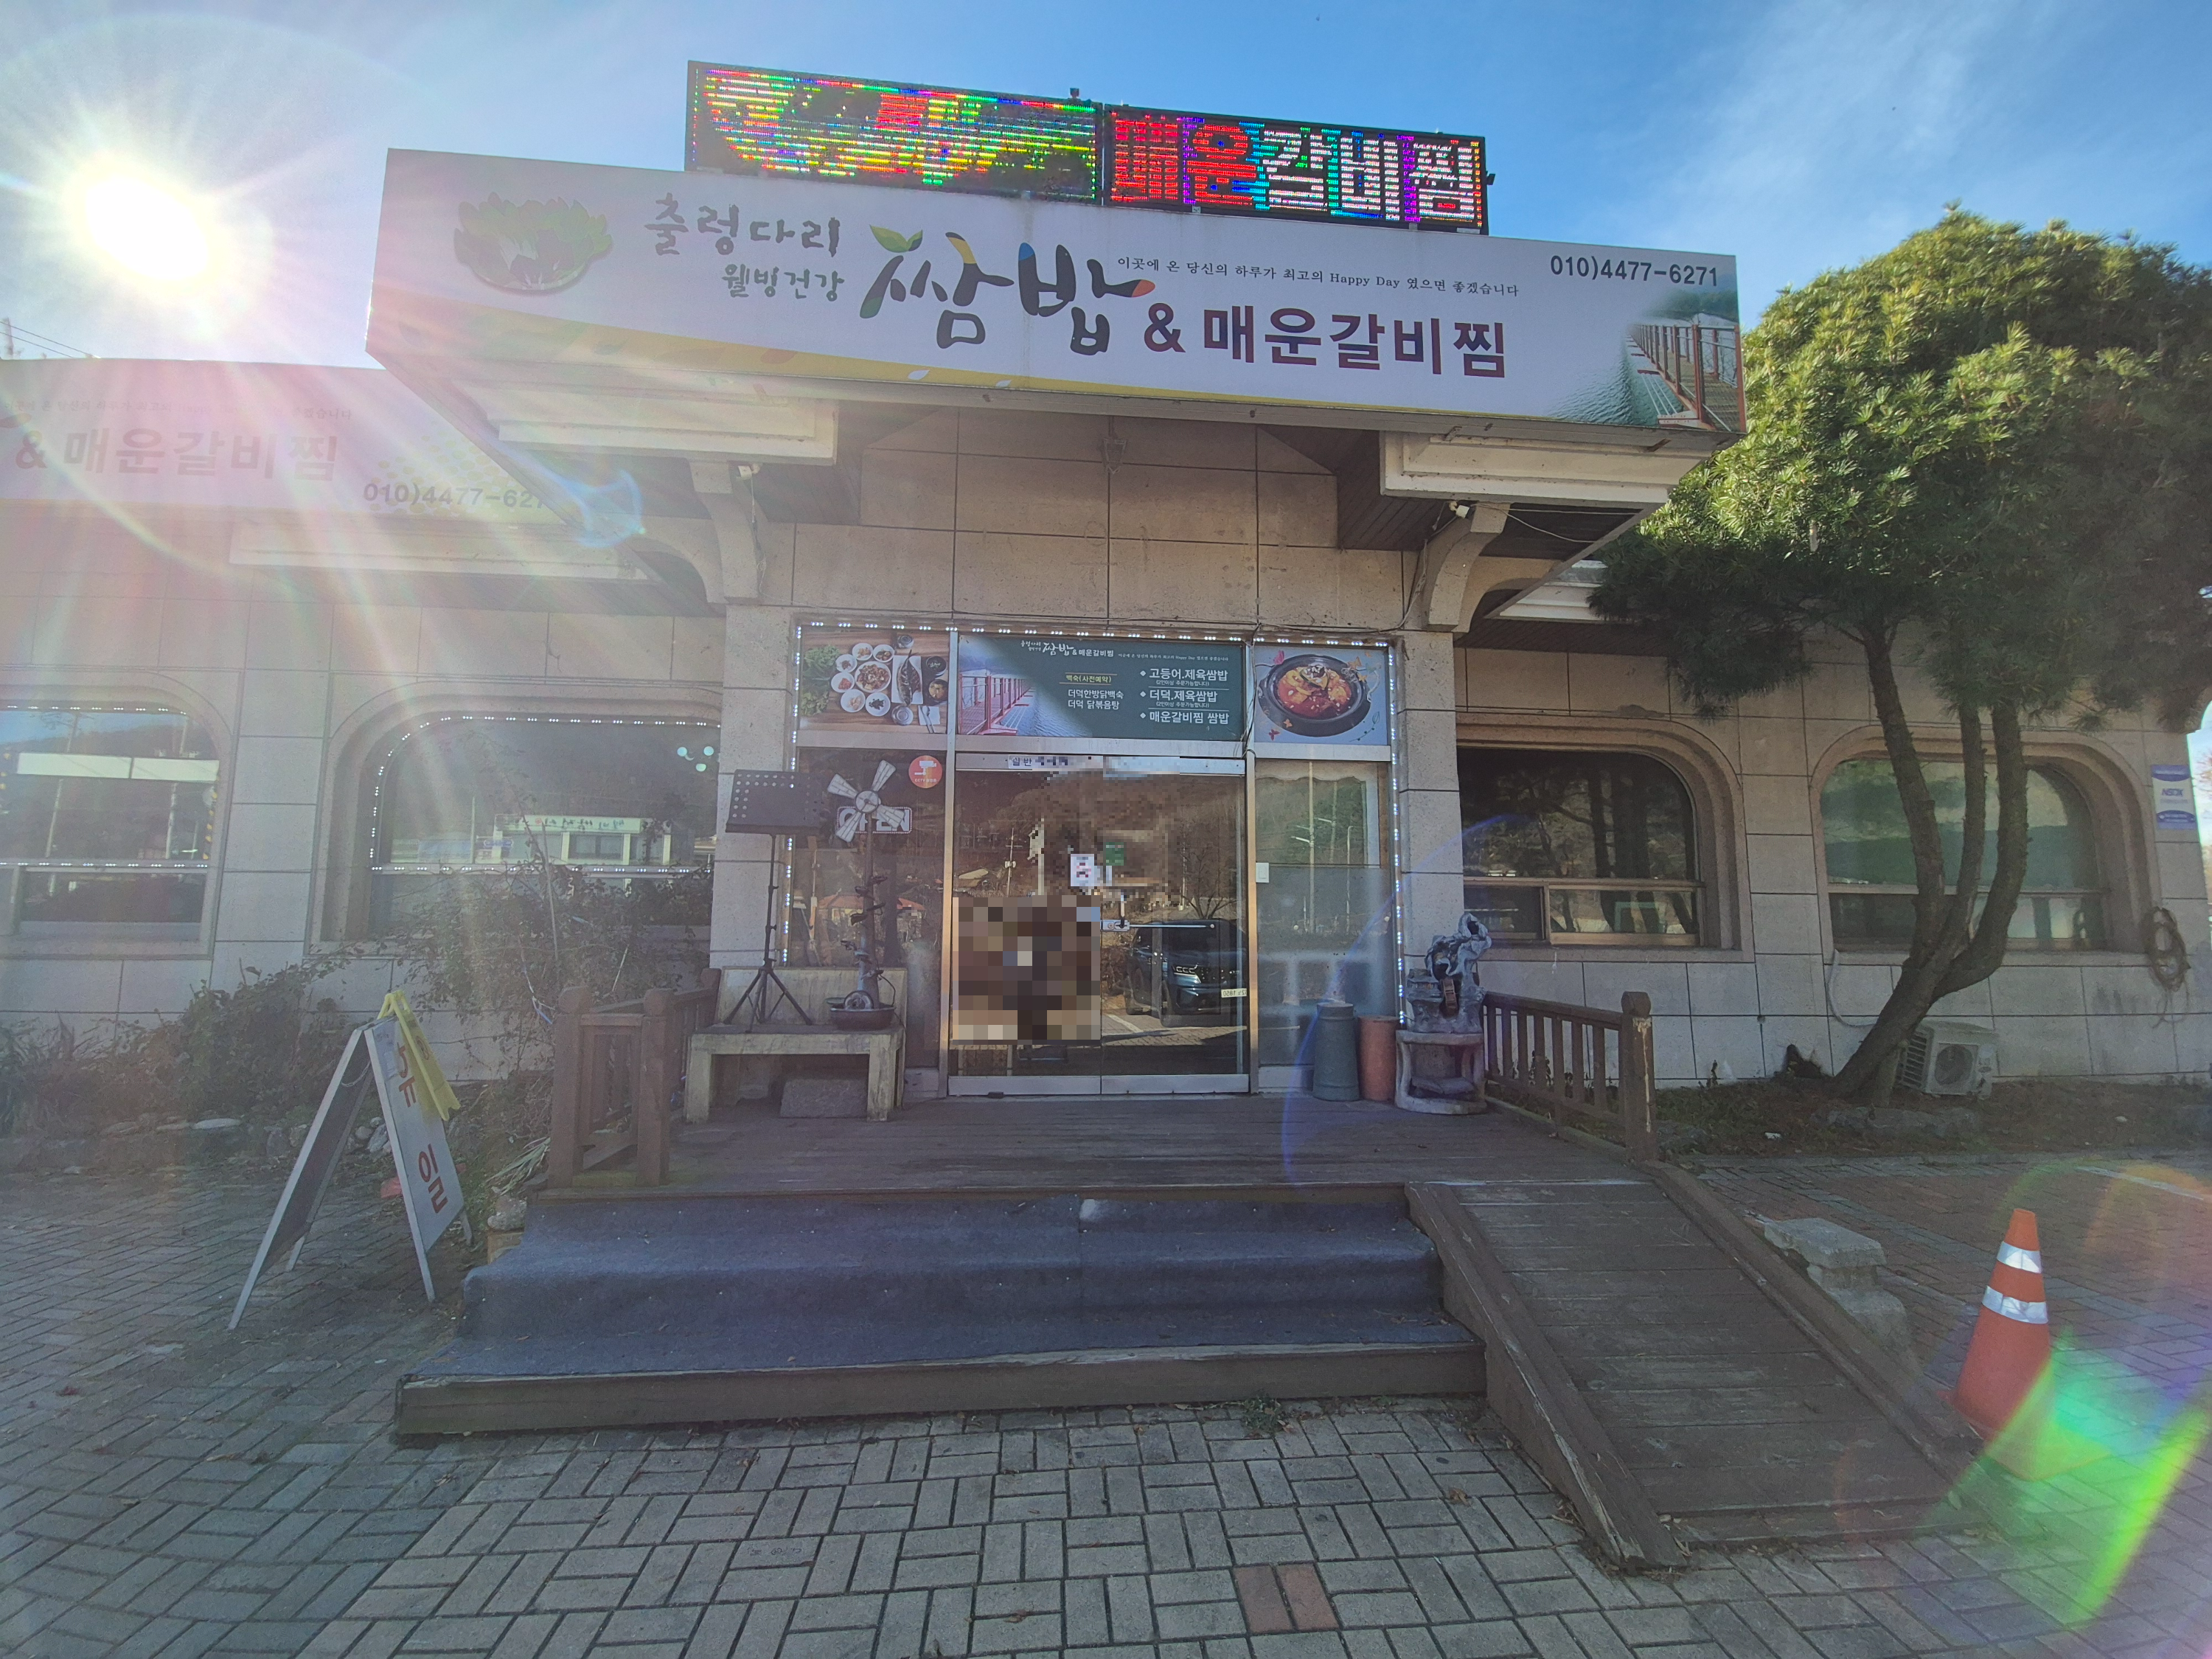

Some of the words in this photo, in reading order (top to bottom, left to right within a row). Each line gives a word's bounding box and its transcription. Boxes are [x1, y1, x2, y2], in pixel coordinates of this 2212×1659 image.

[1112, 116, 1476, 223] 매운갈비찜
[644, 192, 840, 257] 출렁다리
[1117, 257, 1159, 271] 이곳에
[1166, 260, 1180, 273] 온
[1186, 262, 1228, 276] 당신의
[1235, 265, 1277, 279] 하루가
[1283, 268, 1323, 283] 최고의
[1330, 273, 1370, 286] Happy
[1376, 276, 1400, 288] Day
[1407, 277, 1447, 292] 였으면
[1452, 281, 1520, 297] 좋겠습니다
[1550, 255, 1719, 287] 010)4477-6271
[722, 264, 845, 302] 웰빙건강
[860, 224, 1155, 355] 쌈밥
[1144, 302, 1186, 353] &
[1203, 305, 1506, 378] 매운갈비찜
[15, 427, 49, 470] &
[63, 427, 337, 482] 매운갈비찜
[1079, 649, 1115, 657] 매운갈비찜
[1065, 674, 1112, 683] 백숙(사전예약)
[1149, 667, 1228, 681] 고등어.제육쌈밥
[1068, 689, 1124, 699] 더덕한방닭백숙
[1068, 700, 1083, 709] 더덕
[1087, 700, 1119, 710] 닭볶음탕
[1150, 689, 1217, 703] 더덕.제육쌈밥
[1150, 711, 1203, 723] 매운갈비찜
[1207, 712, 1229, 725] 쌈밥
